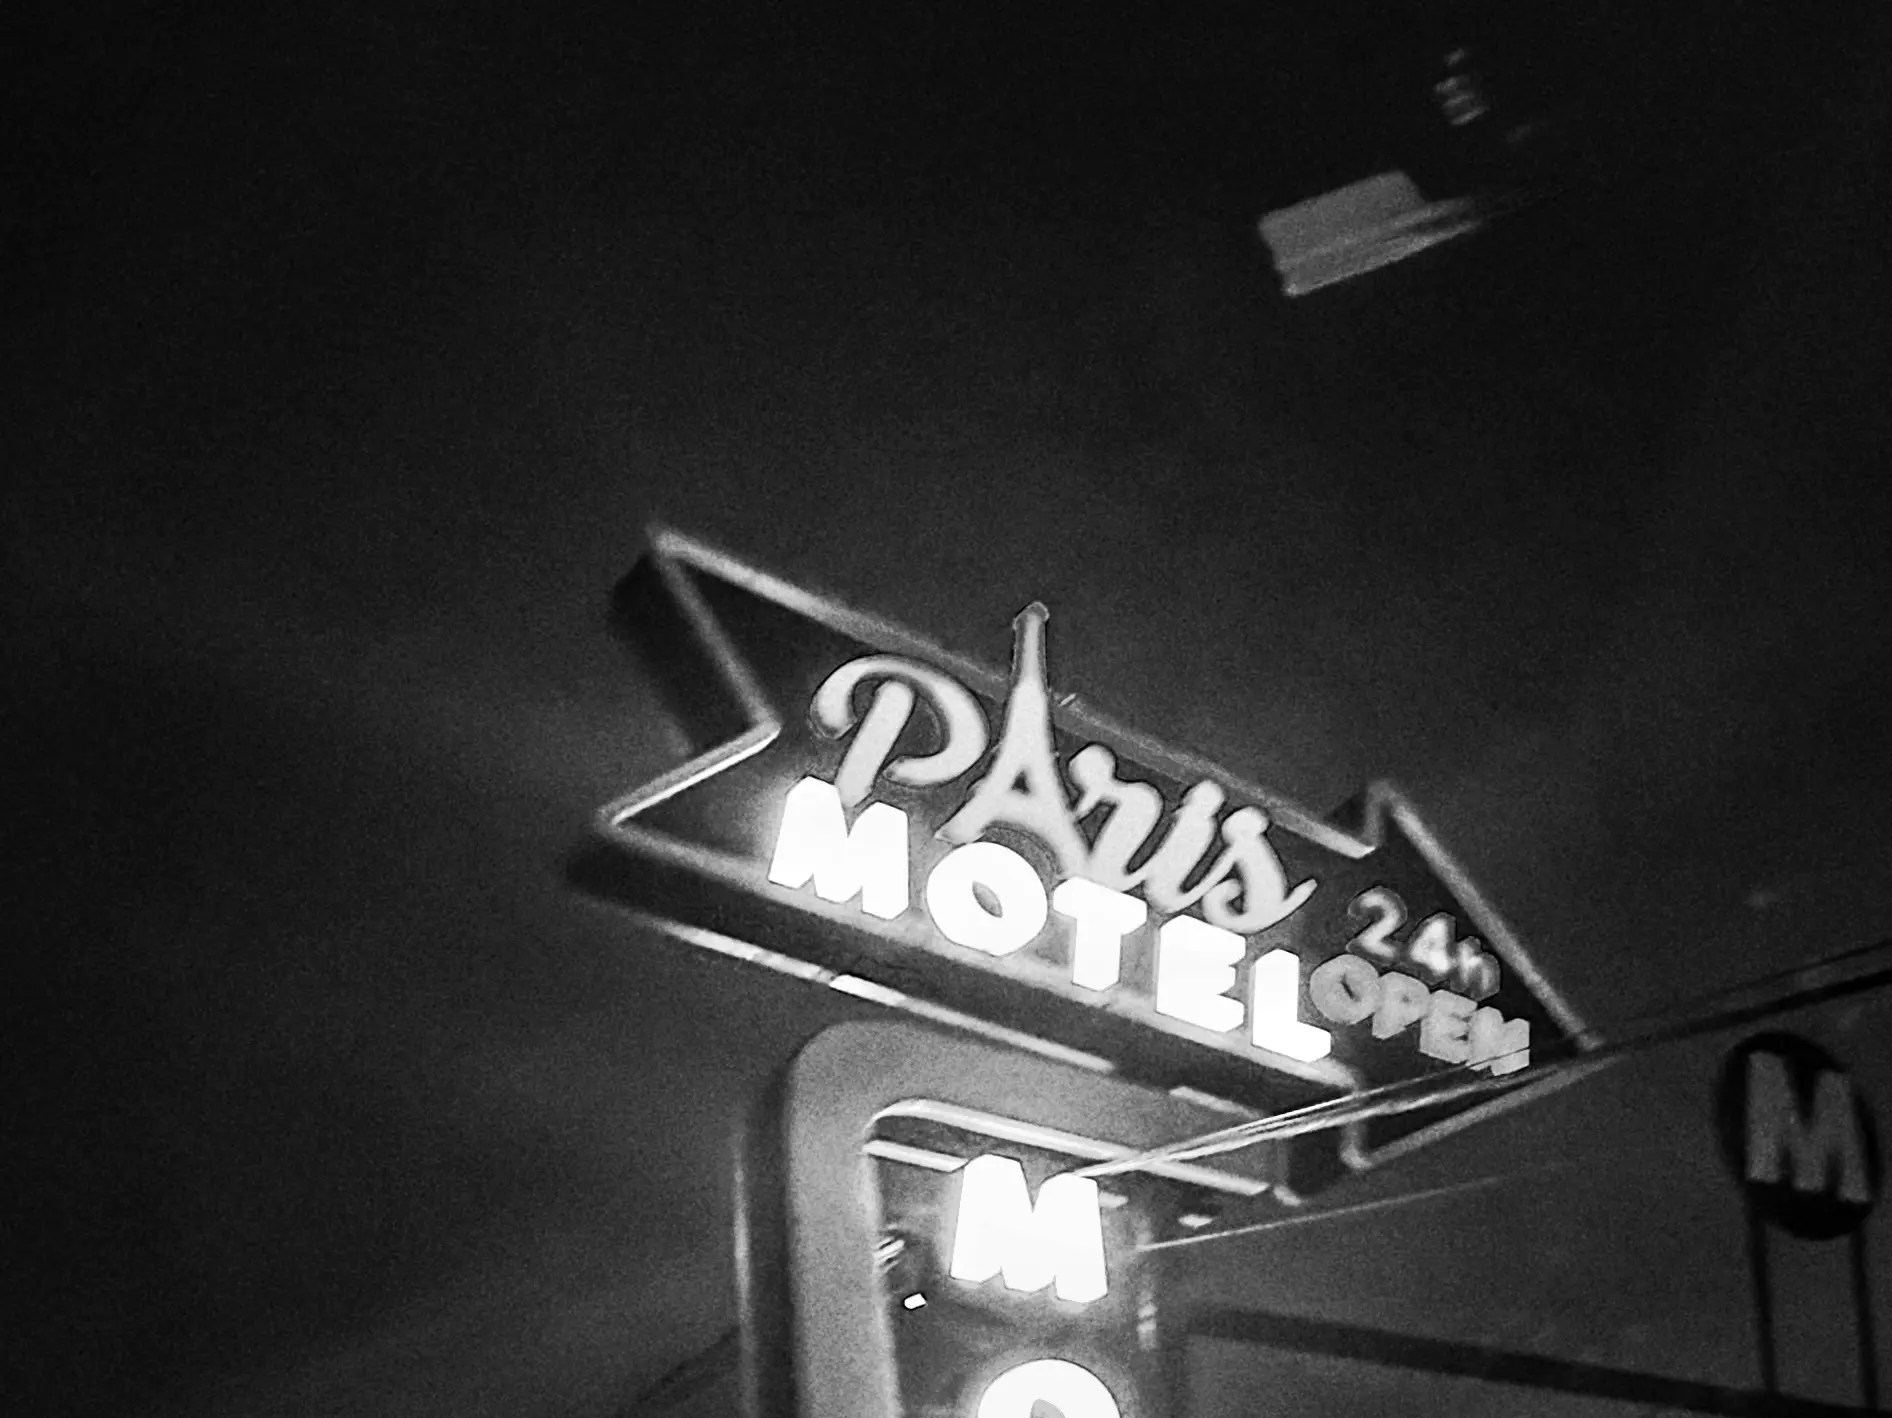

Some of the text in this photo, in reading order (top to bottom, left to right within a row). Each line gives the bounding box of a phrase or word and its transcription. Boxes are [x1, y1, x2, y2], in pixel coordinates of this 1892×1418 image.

[768, 776, 1333, 1063] MOTEL
[1346, 885, 1500, 1001] 24h
[1309, 953, 1531, 1077] OPEN
